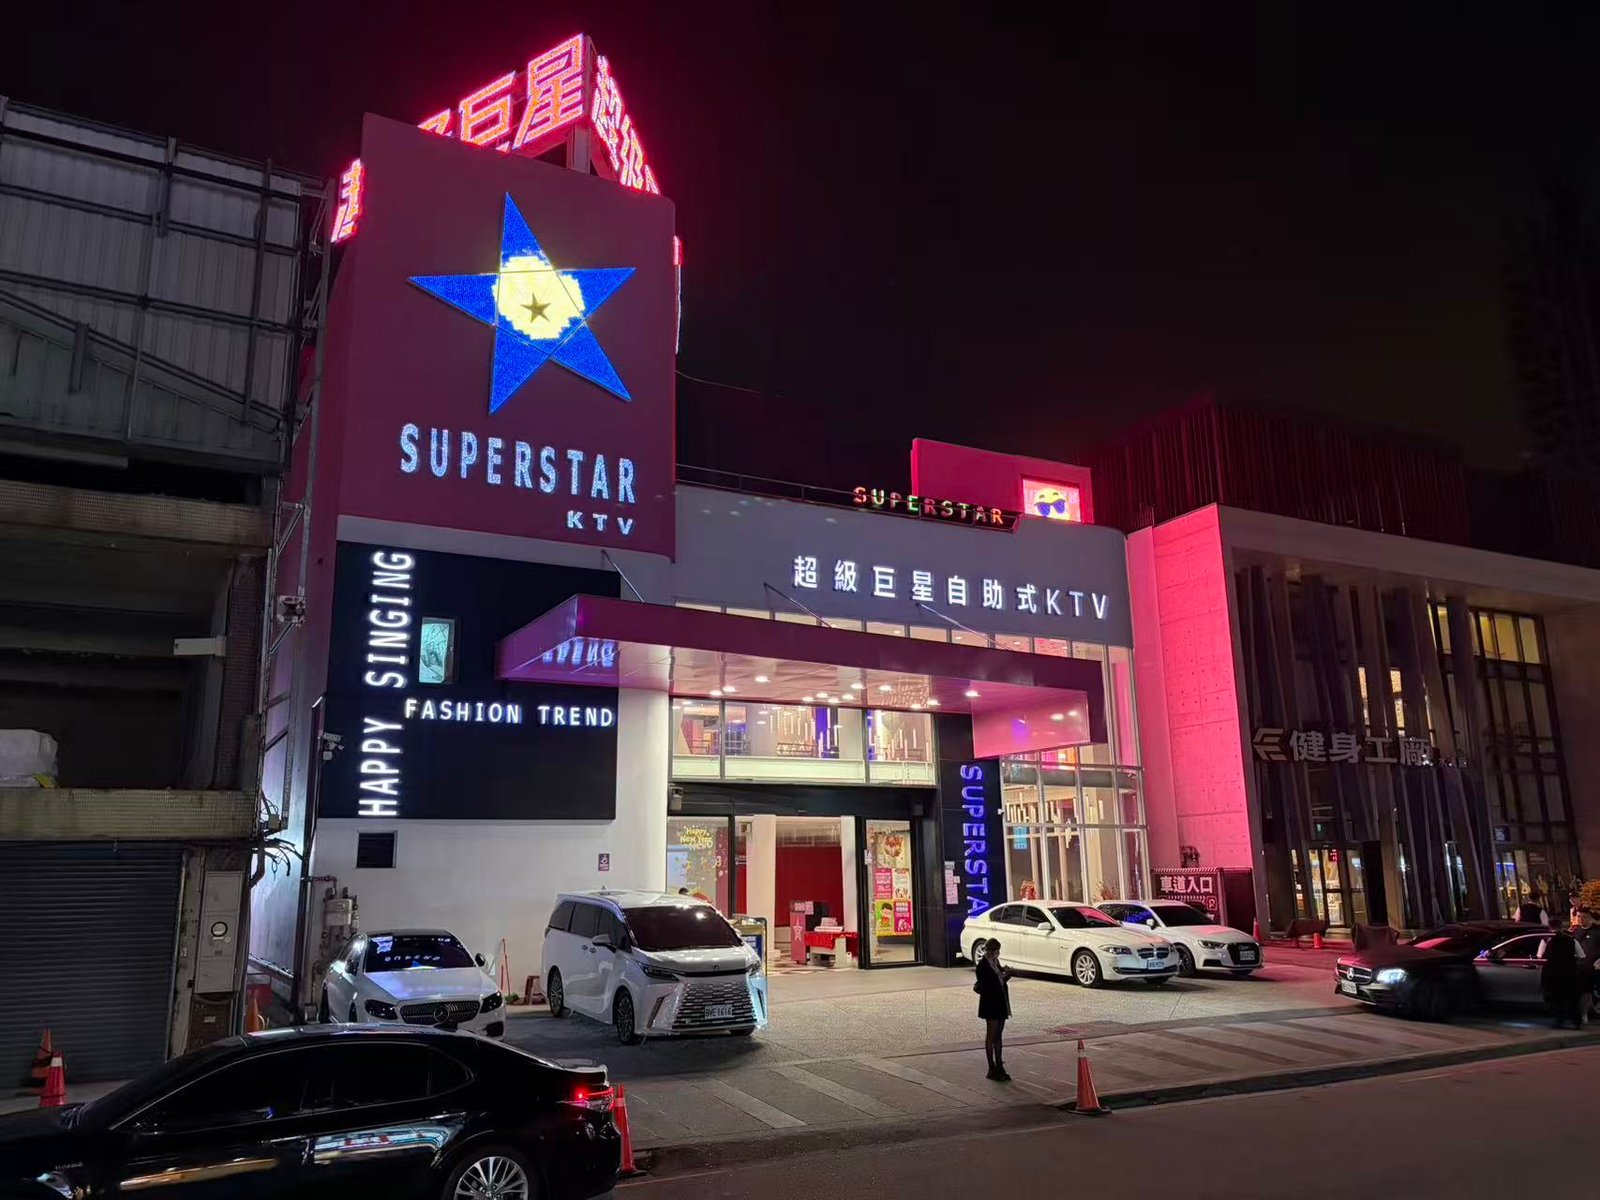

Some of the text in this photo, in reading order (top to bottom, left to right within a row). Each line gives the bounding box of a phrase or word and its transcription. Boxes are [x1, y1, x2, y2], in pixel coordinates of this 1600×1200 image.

[400, 422, 636, 504] SUPERSTAR
[567, 510, 634, 536] KTV
[853, 486, 1004, 525] SUPERSTAR
[358, 551, 417, 816] HAPPY SINGING
[404, 698, 614, 727] FASHION TREND
[960, 764, 990, 918] SUPERSTA
[1160, 875, 1213, 893] 車道入口
